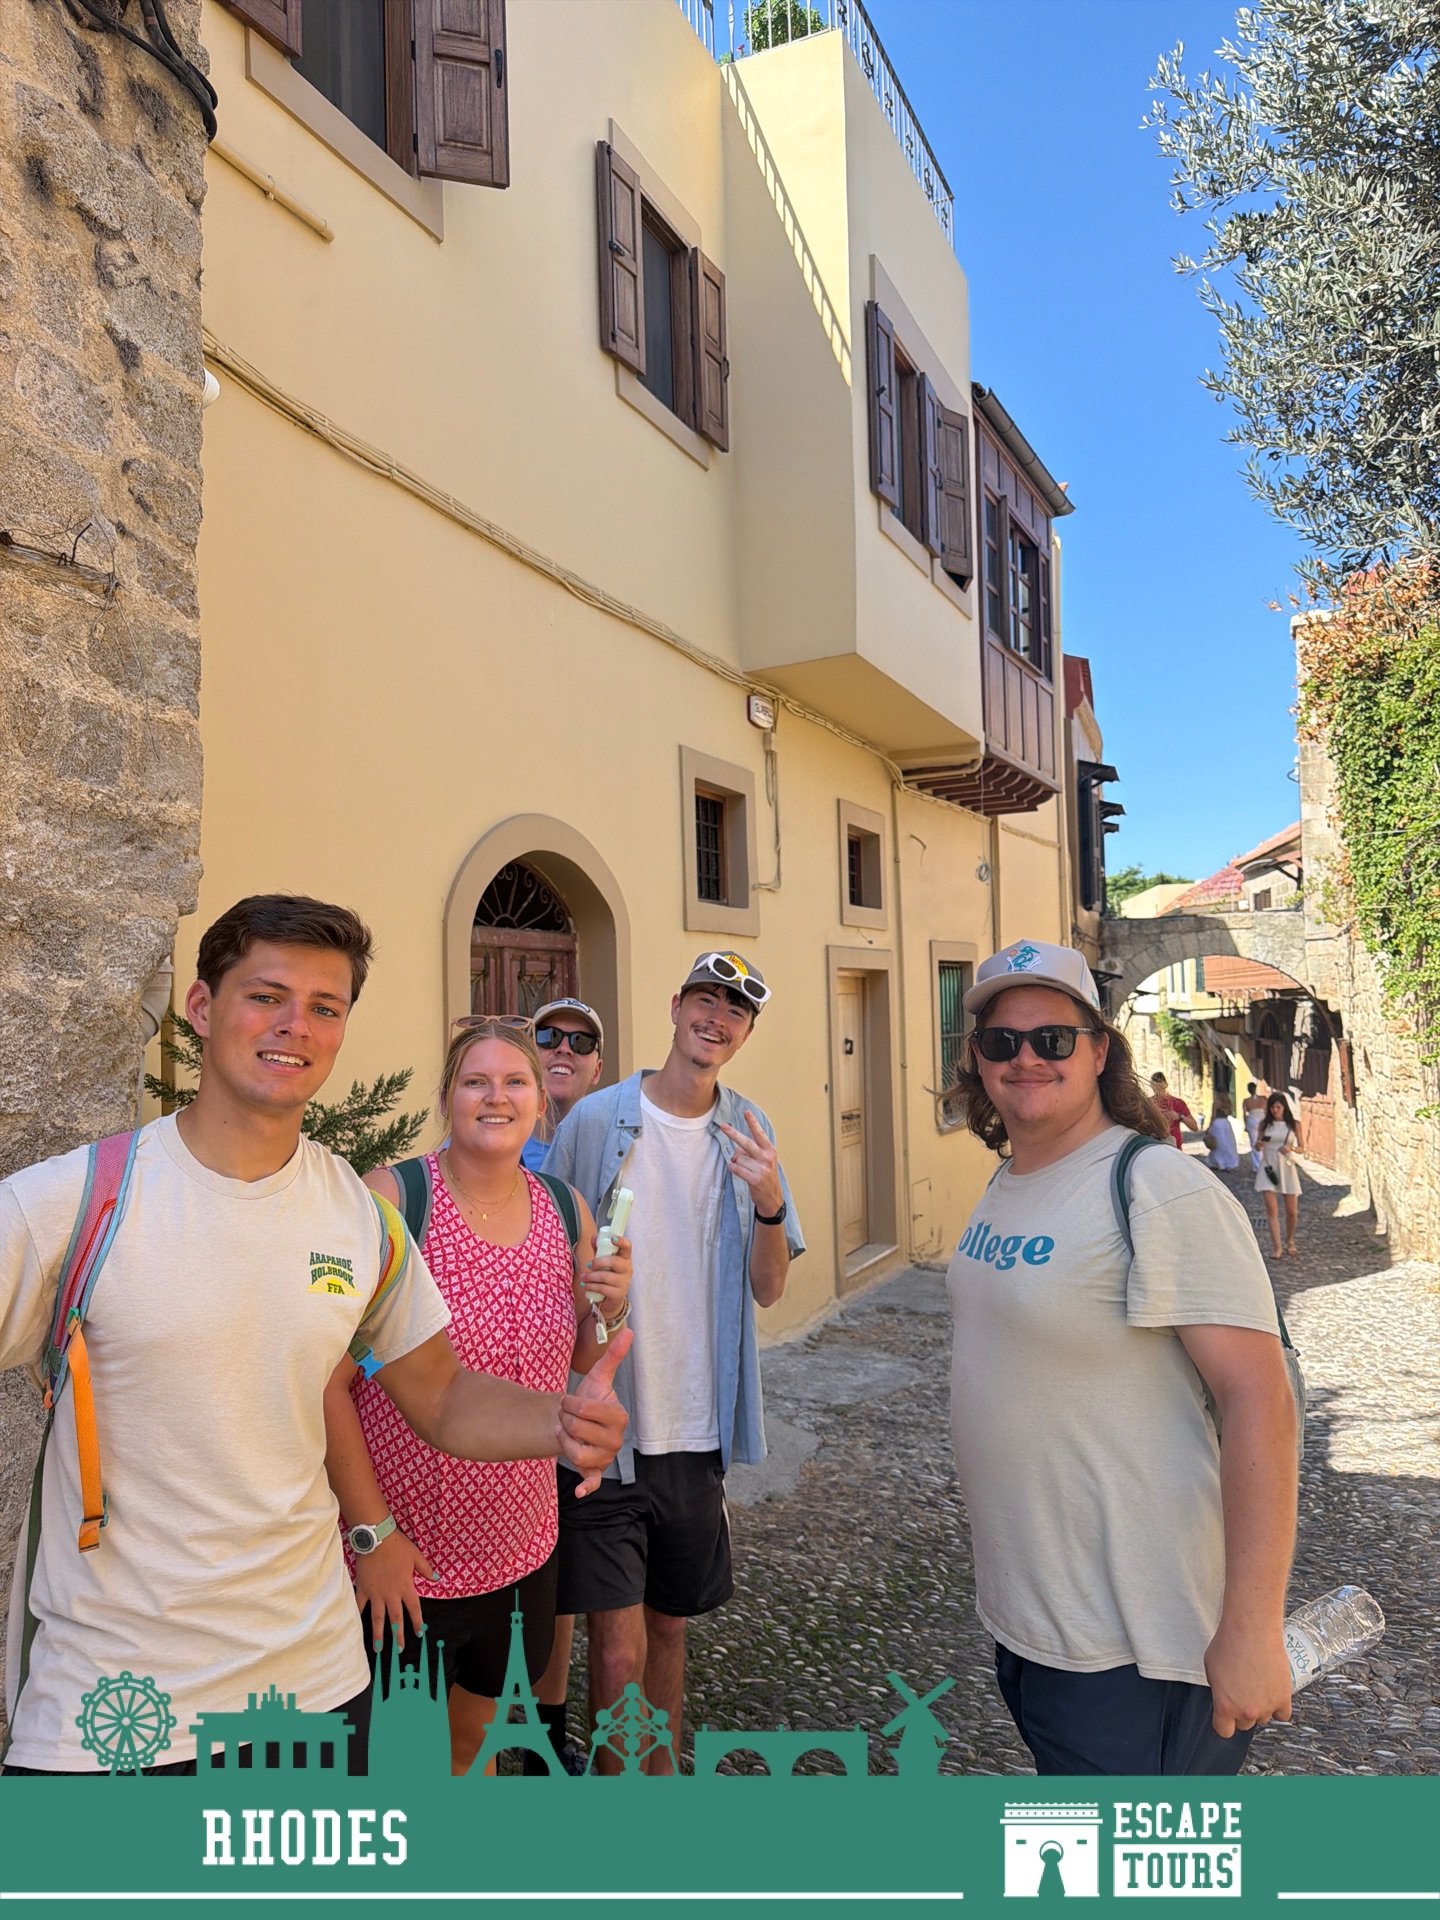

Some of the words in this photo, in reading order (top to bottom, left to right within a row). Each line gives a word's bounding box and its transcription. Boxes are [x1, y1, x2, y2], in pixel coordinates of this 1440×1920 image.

[310, 1251, 353, 1272] ARAPAHOE
[311, 1266, 355, 1289] HOLBROOK
[327, 1282, 345, 1294] FFA
